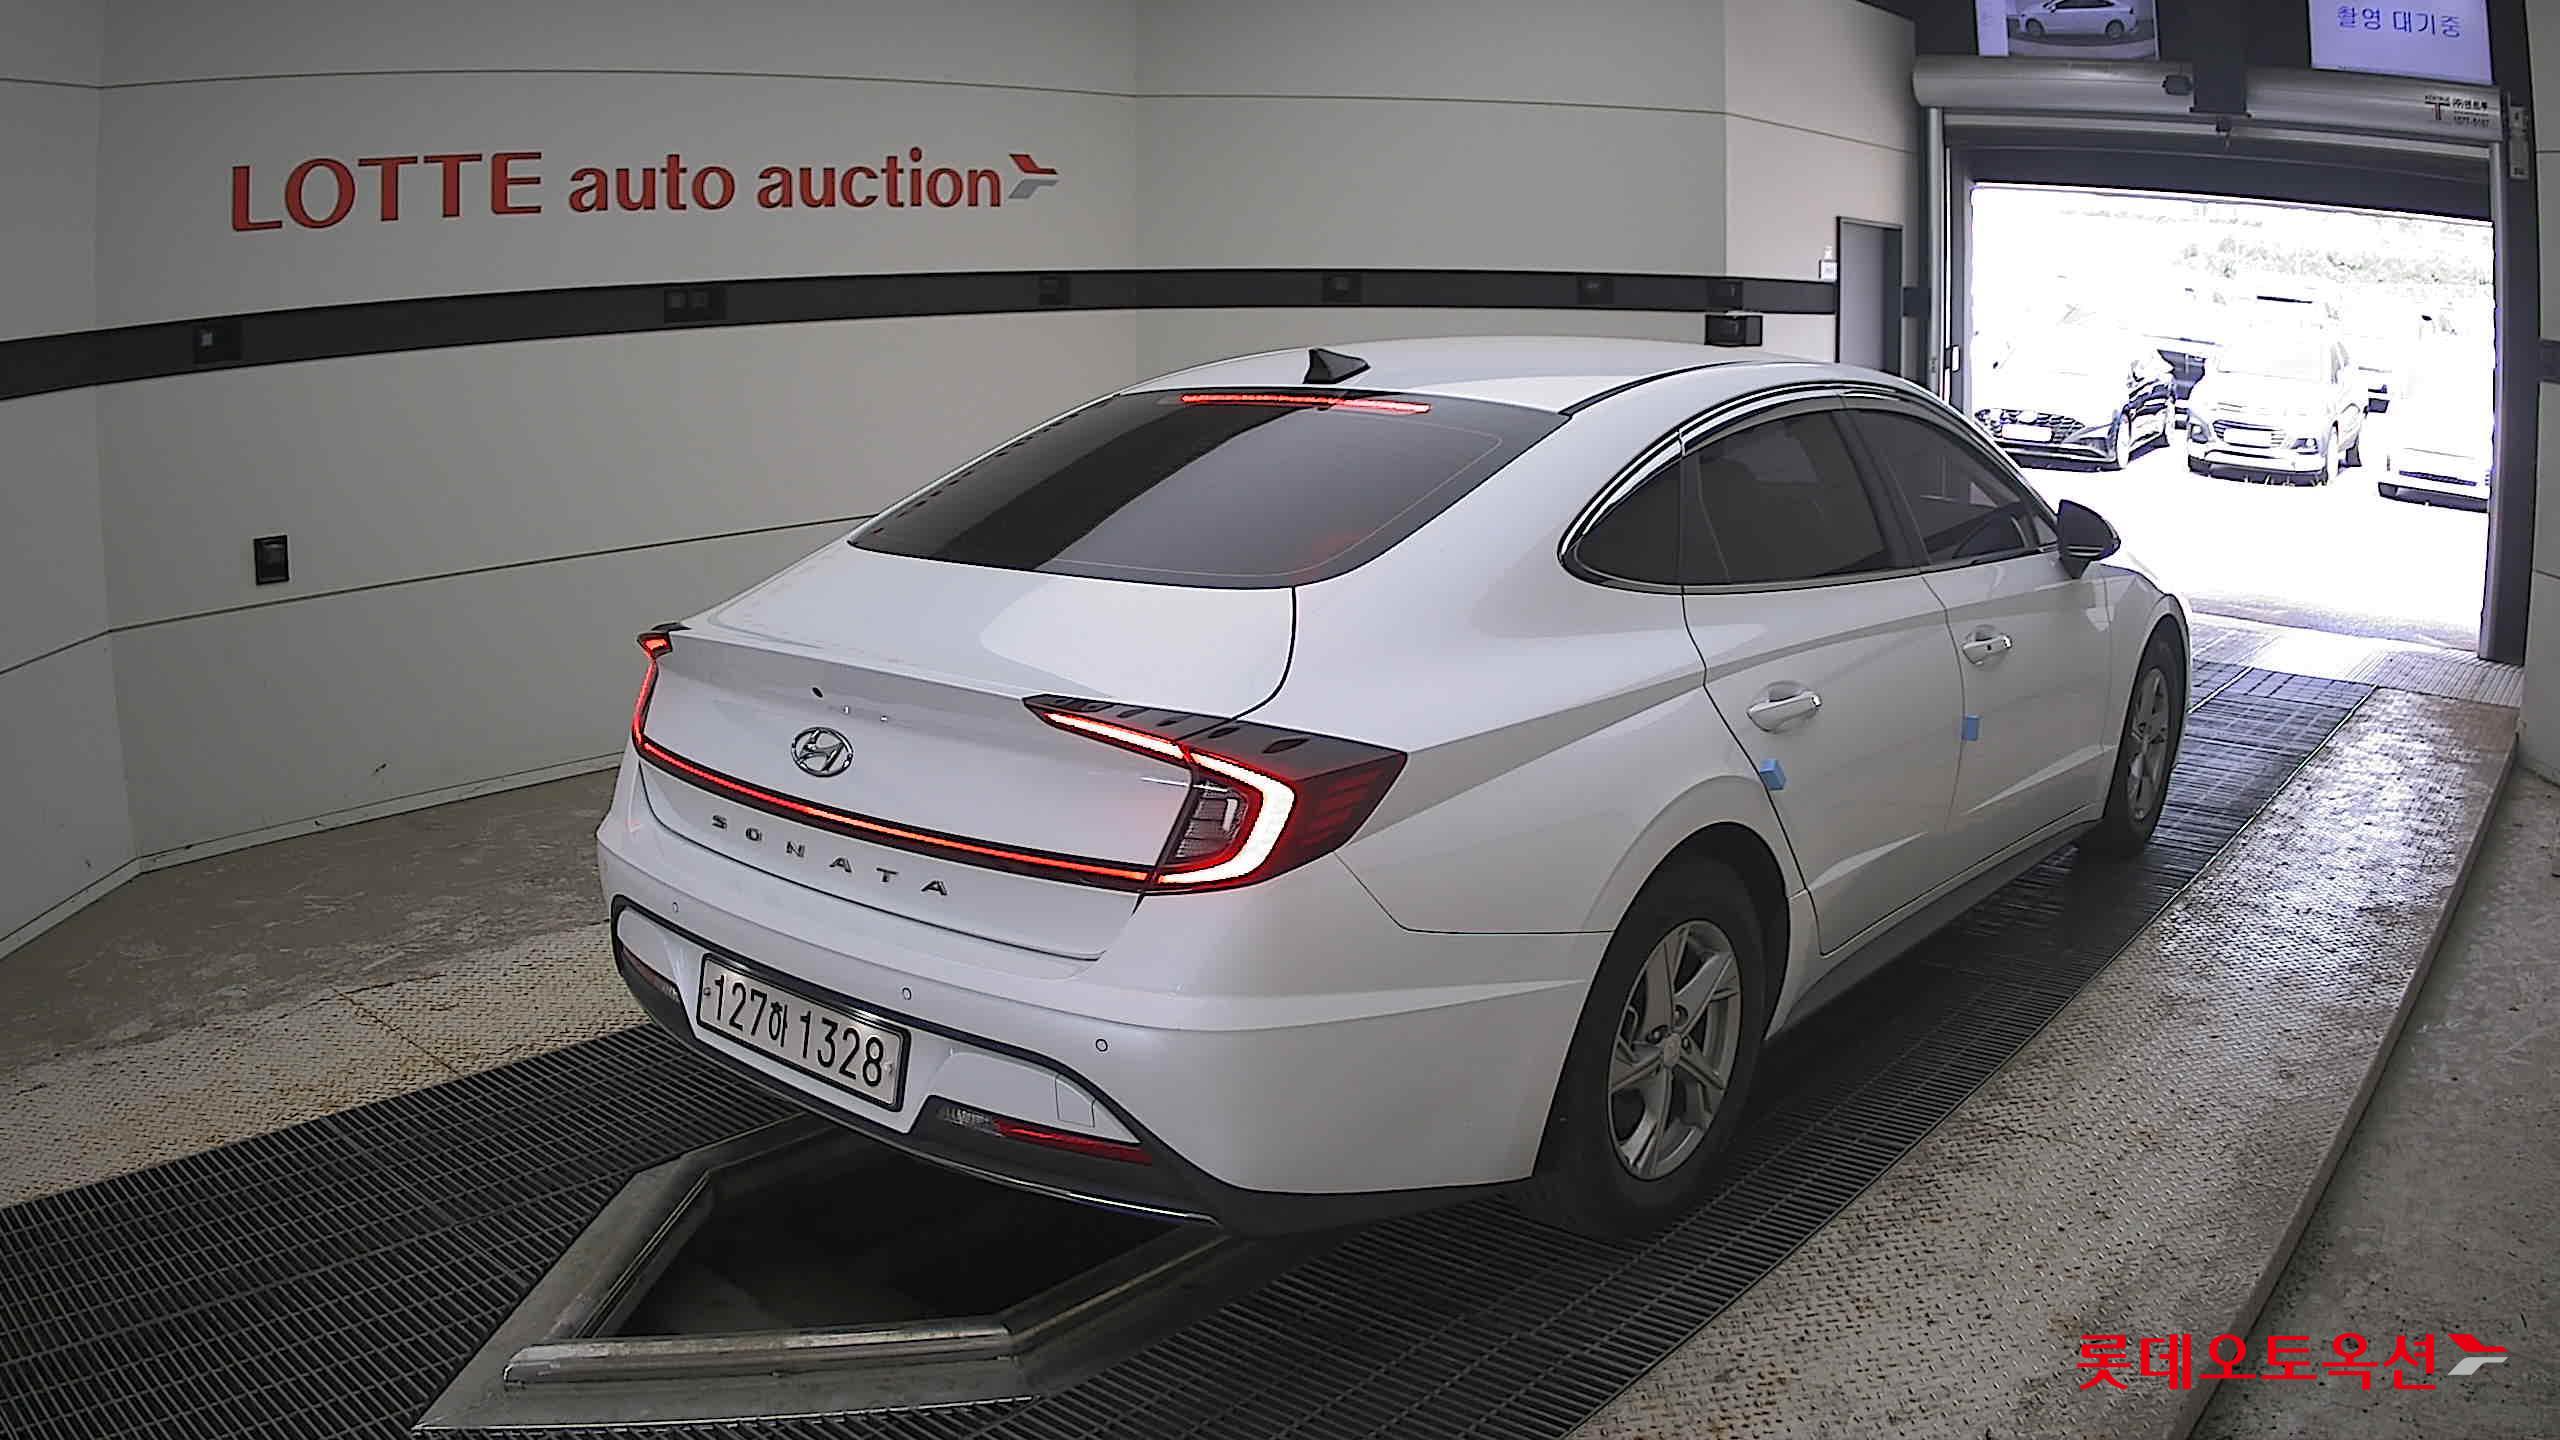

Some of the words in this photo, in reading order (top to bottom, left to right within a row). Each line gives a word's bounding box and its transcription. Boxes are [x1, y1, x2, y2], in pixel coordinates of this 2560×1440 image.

[2337, 5, 2382, 31] 촬영
[2392, 10, 2461, 39] 대기중
[231, 151, 543, 232] LOTTE
[567, 153, 737, 212] auto
[756, 147, 1002, 209] auction
[711, 814, 948, 896] SONATA
[714, 974, 789, 1048] 127하
[800, 1010, 885, 1087] 1328
